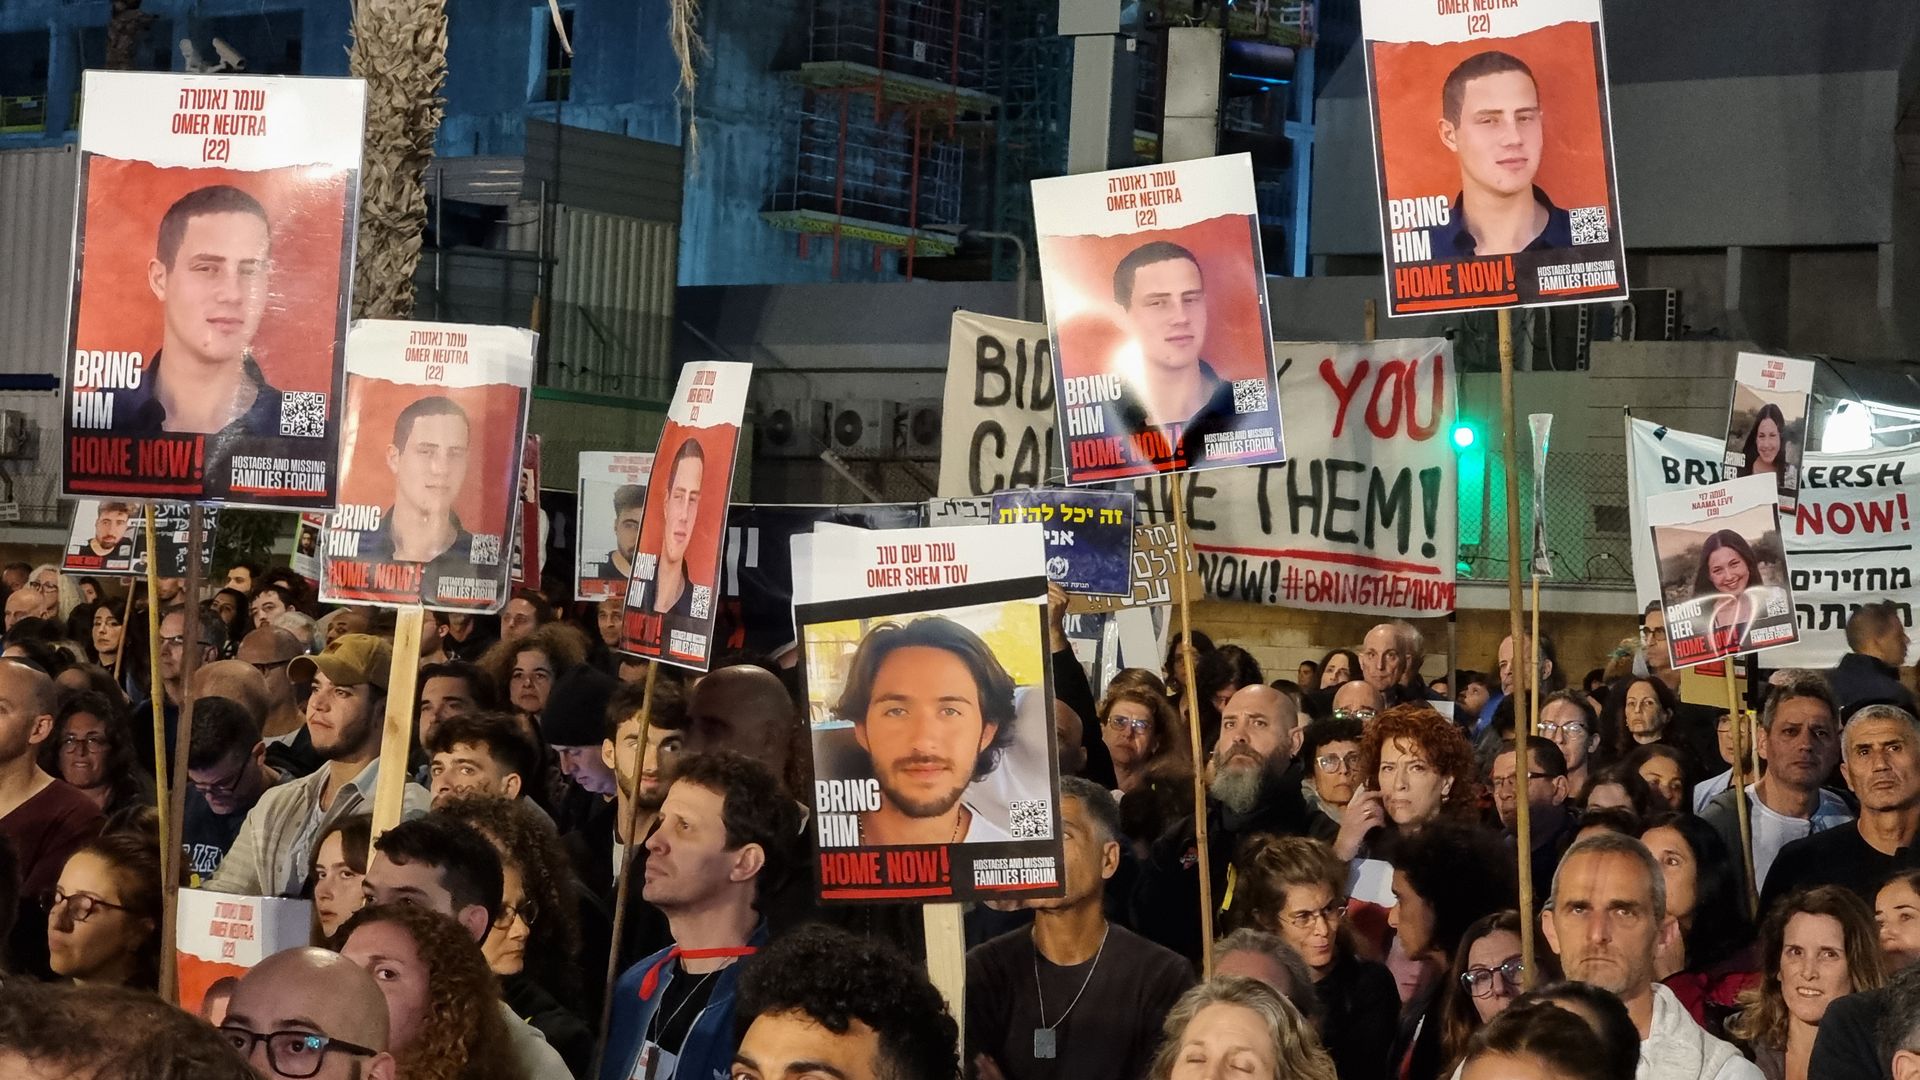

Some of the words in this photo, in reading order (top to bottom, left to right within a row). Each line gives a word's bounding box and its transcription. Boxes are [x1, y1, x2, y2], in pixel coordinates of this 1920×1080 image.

[1467, 13, 1491, 35] (22)
[179, 88, 228, 110] נאוטרה
[233, 88, 266, 111] עומר
[172, 113, 210, 135] OMER
[213, 114, 267, 136] NEUTRA
[202, 138, 230, 162] (22)
[1108, 173, 1147, 194] נאוטרה
[1148, 169, 1176, 189] עומר
[1106, 192, 1138, 212] OMER
[1140, 188, 1183, 208] NEUTRA
[1135, 209, 1158, 228] (22)
[1388, 195, 1450, 230] BRING
[1393, 231, 1432, 263] HIM
[1395, 264, 1454, 299] HOME
[1457, 256, 1516, 294] NOW!
[1537, 264, 1571, 277] HOSTAGES
[1571, 262, 1585, 274] AND
[1585, 259, 1615, 272] MISSING
[1539, 273, 1581, 291] FAMILIES
[1582, 270, 1617, 287] FORUM
[410, 330, 443, 347] נאוטרה
[444, 331, 468, 348] עומר
[405, 348, 430, 363] OMER
[432, 349, 469, 365] NEUTRA
[74, 350, 142, 389] BRING
[425, 364, 444, 382] (22)
[974, 335, 1055, 411] BID
[1319, 355, 1444, 442] YOU
[1064, 374, 1122, 406] BRING
[71, 391, 115, 430] HIM
[1068, 405, 1105, 437] HIM
[1071, 437, 1126, 470] HOME
[1129, 426, 1185, 464] NOW!
[1204, 431, 1235, 444] HOSTAGES
[1234, 430, 1247, 441] AND
[1205, 440, 1244, 457] FAMILIES
[1244, 436, 1276, 453] FORUM
[72, 436, 132, 476] HOME
[139, 435, 205, 479] NOW!
[231, 455, 271, 471] HOSTAGES
[272, 457, 290, 472] AND
[290, 459, 326, 474] MISSING
[231, 469, 282, 490] FAMILIES
[284, 472, 325, 492] FORUM
[1661, 455, 1723, 485] BRI
[1692, 500, 1716, 511] NAAMA
[1717, 496, 1734, 507] LEVY
[1709, 488, 1726, 499] נעמה
[331, 503, 381, 532] BRING
[1060, 503, 1094, 523] יכל
[1099, 508, 1123, 525] זה
[1249, 457, 1442, 558] THEM!
[1795, 493, 1911, 536] NOW!
[328, 531, 360, 557] HIM
[901, 543, 922, 565] שם
[925, 542, 956, 563] עומר
[876, 545, 898, 566] טוב
[328, 561, 370, 588] HOME
[374, 563, 422, 592] NOW!
[866, 568, 901, 588] OMER
[905, 566, 941, 586] SHEM
[943, 563, 969, 585] TOV
[1197, 553, 1281, 603] NOW!
[1790, 567, 1912, 591] מחזירים
[437, 585, 470, 599] FAMILIES
[1667, 600, 1701, 622] BRING
[1670, 620, 1694, 640] HER
[1674, 636, 1707, 658] HOME
[815, 778, 881, 813] BRING
[818, 814, 860, 847] HIM
[821, 851, 881, 886] HOME
[887, 845, 951, 885] NOW!
[973, 858, 1008, 871] HOSTAGES
[1008, 857, 1023, 869] AND
[1023, 856, 1056, 869] MISSING
[974, 868, 1019, 886] FAMILIES
[1020, 867, 1057, 884] FORUM
